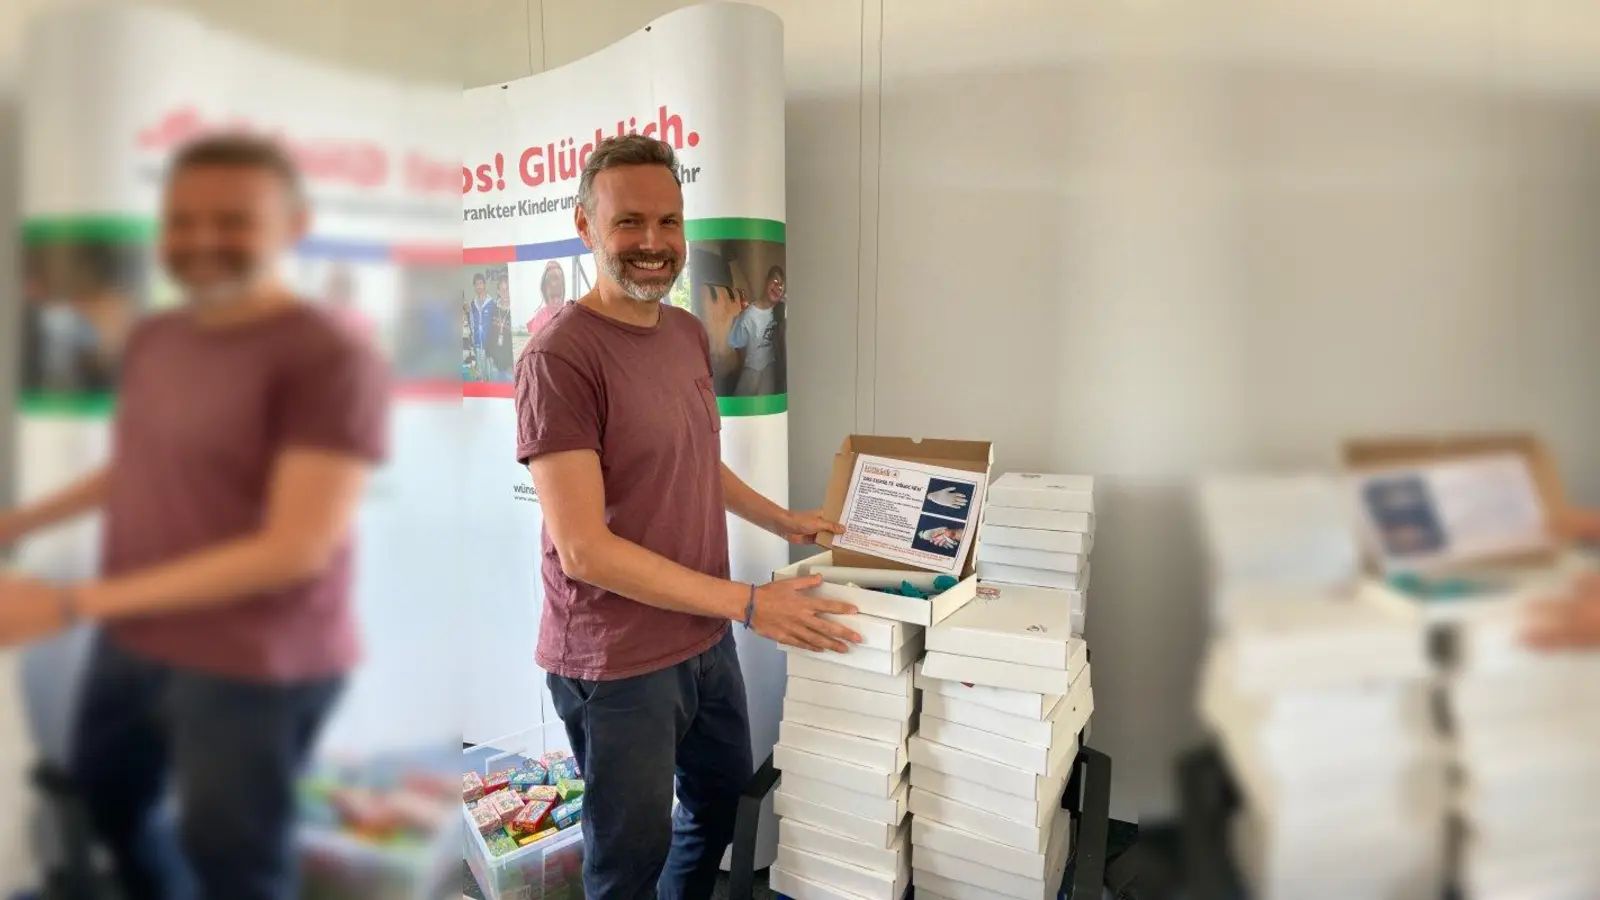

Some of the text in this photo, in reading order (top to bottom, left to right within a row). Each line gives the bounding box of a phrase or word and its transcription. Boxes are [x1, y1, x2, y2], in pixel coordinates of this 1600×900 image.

[462, 204, 516, 221] rankter
[518, 197, 559, 217] Kinder
[678, 164, 701, 184] hr
